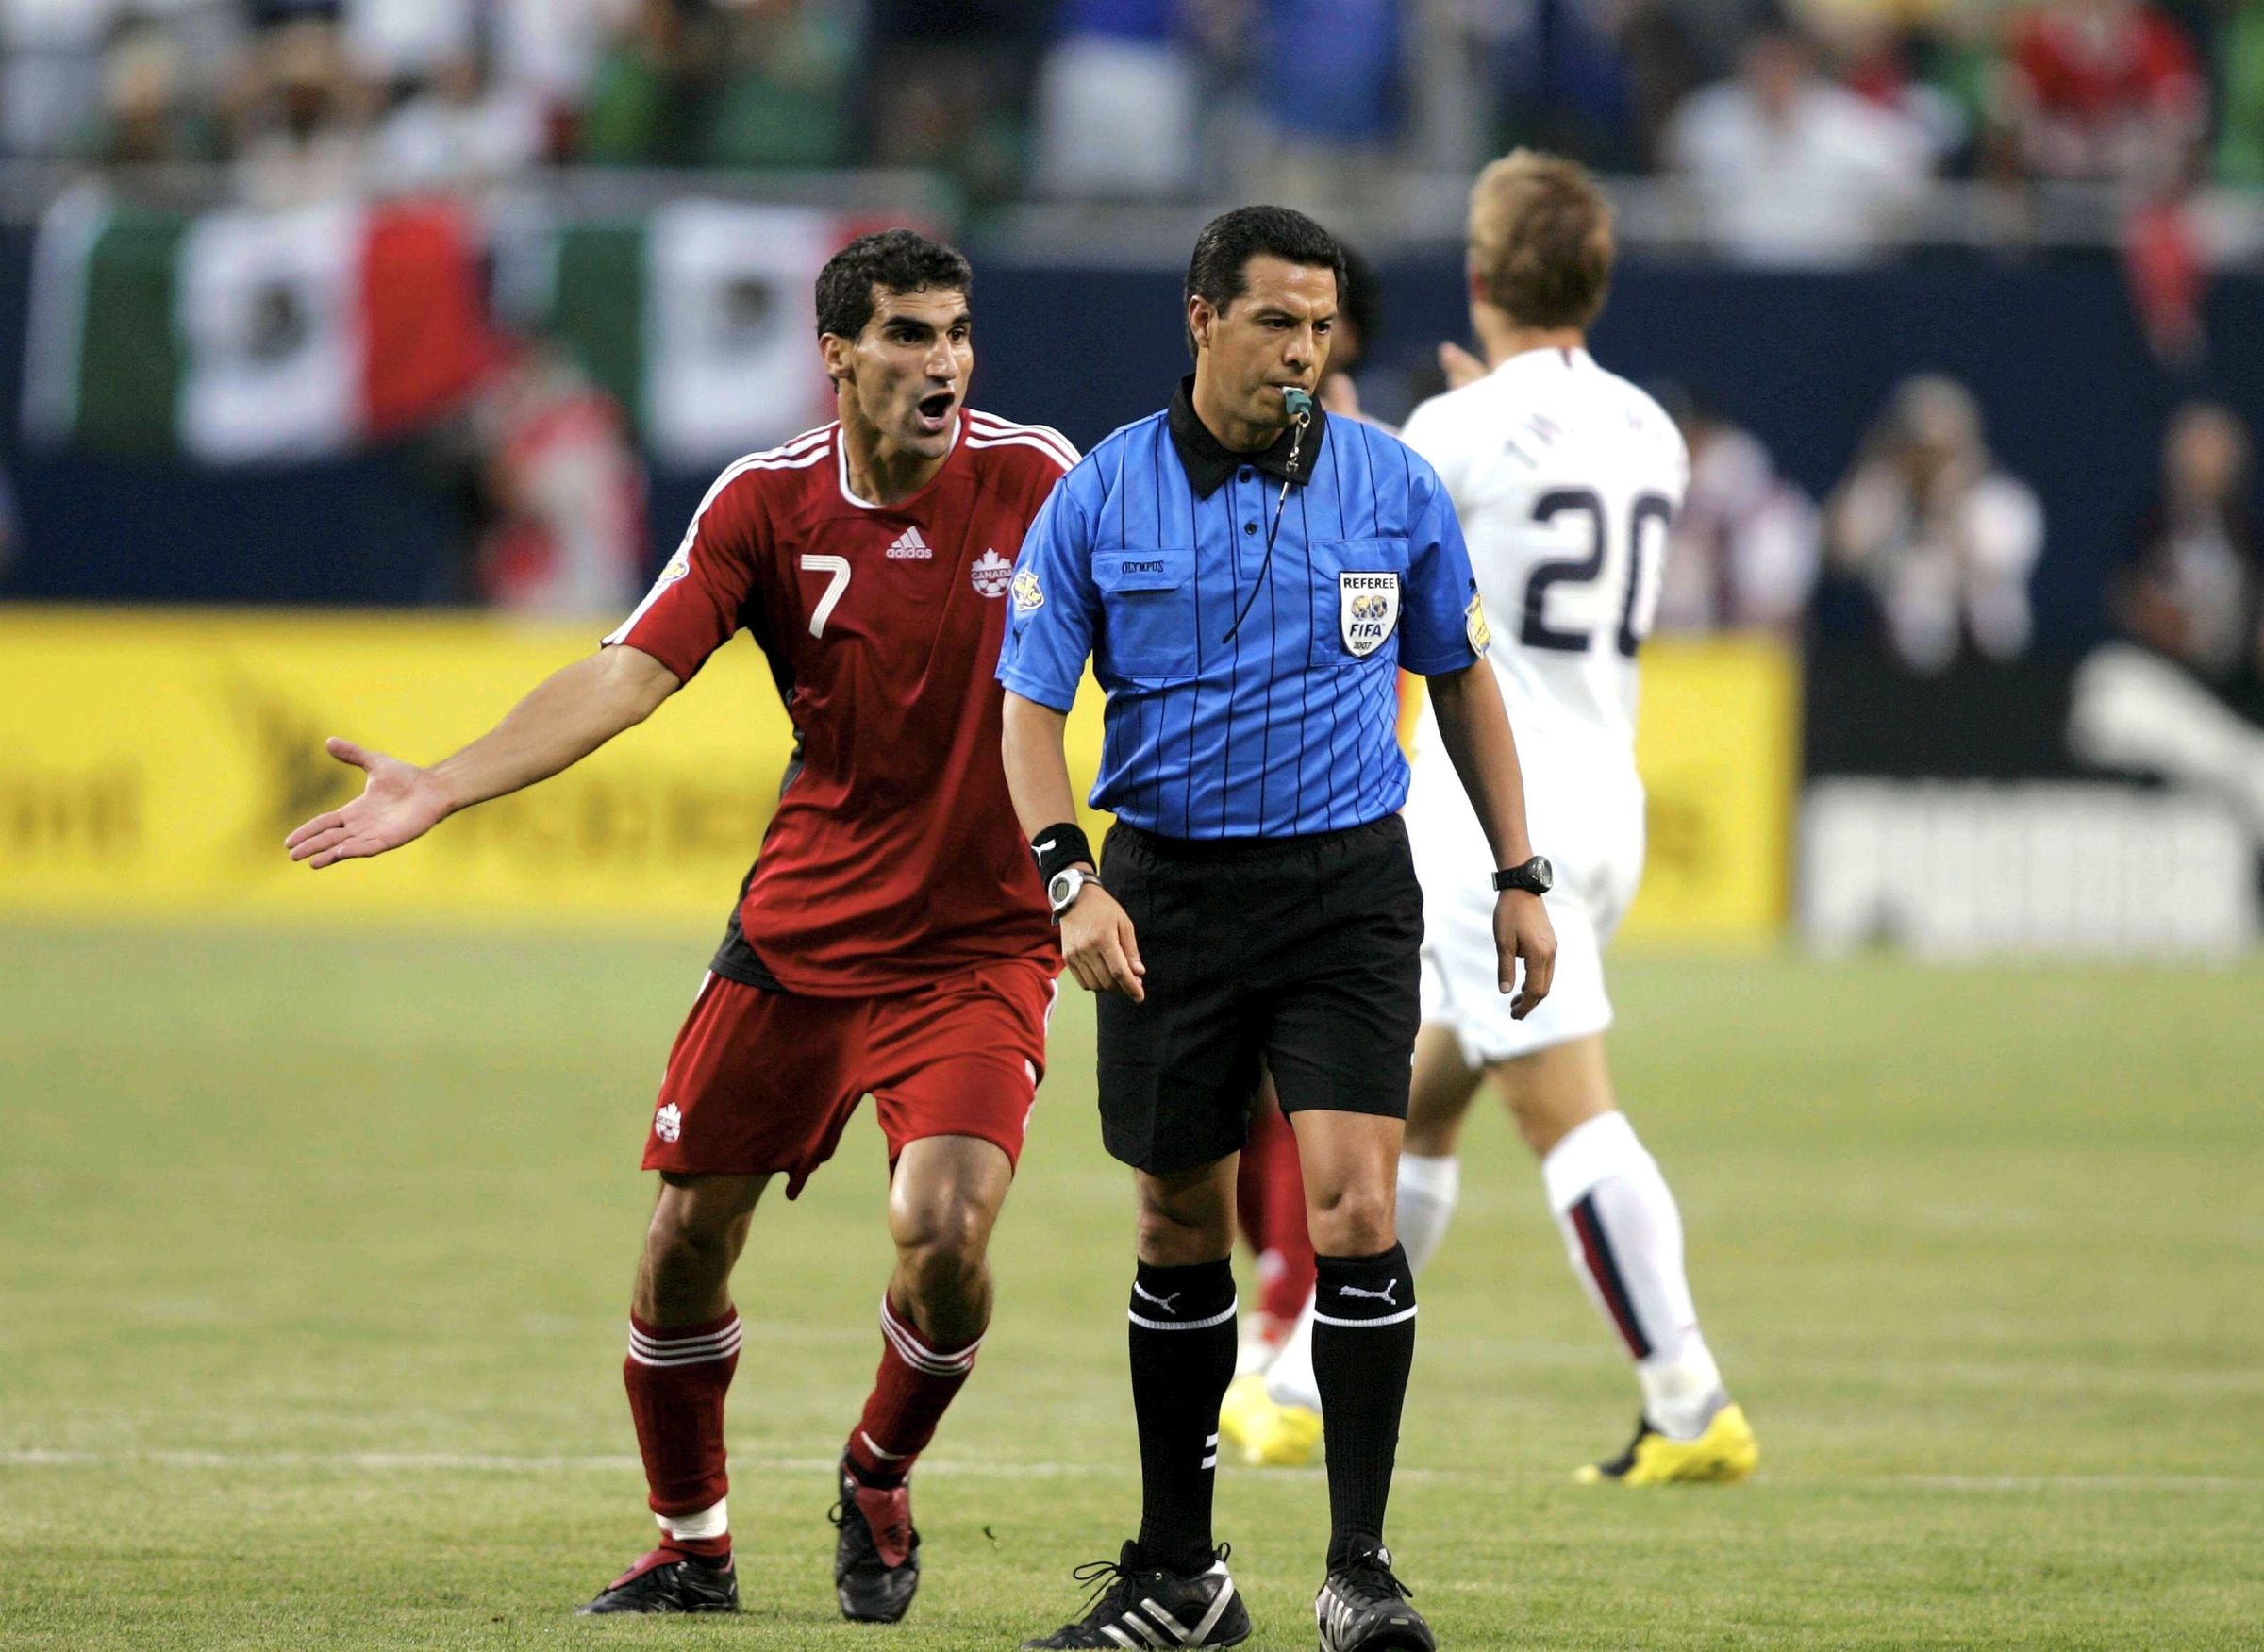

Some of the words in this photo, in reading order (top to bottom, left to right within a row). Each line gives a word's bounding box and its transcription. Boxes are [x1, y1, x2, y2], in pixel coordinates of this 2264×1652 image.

[886, 547, 933, 559] adidas
[971, 568, 1012, 580] CANADA
[1521, 487, 1672, 658] 20
[1343, 577, 1395, 589] REFEREE
[800, 553, 852, 640] 7
[1349, 623, 1382, 638] FIFA
[1353, 641, 1373, 650] 2007
